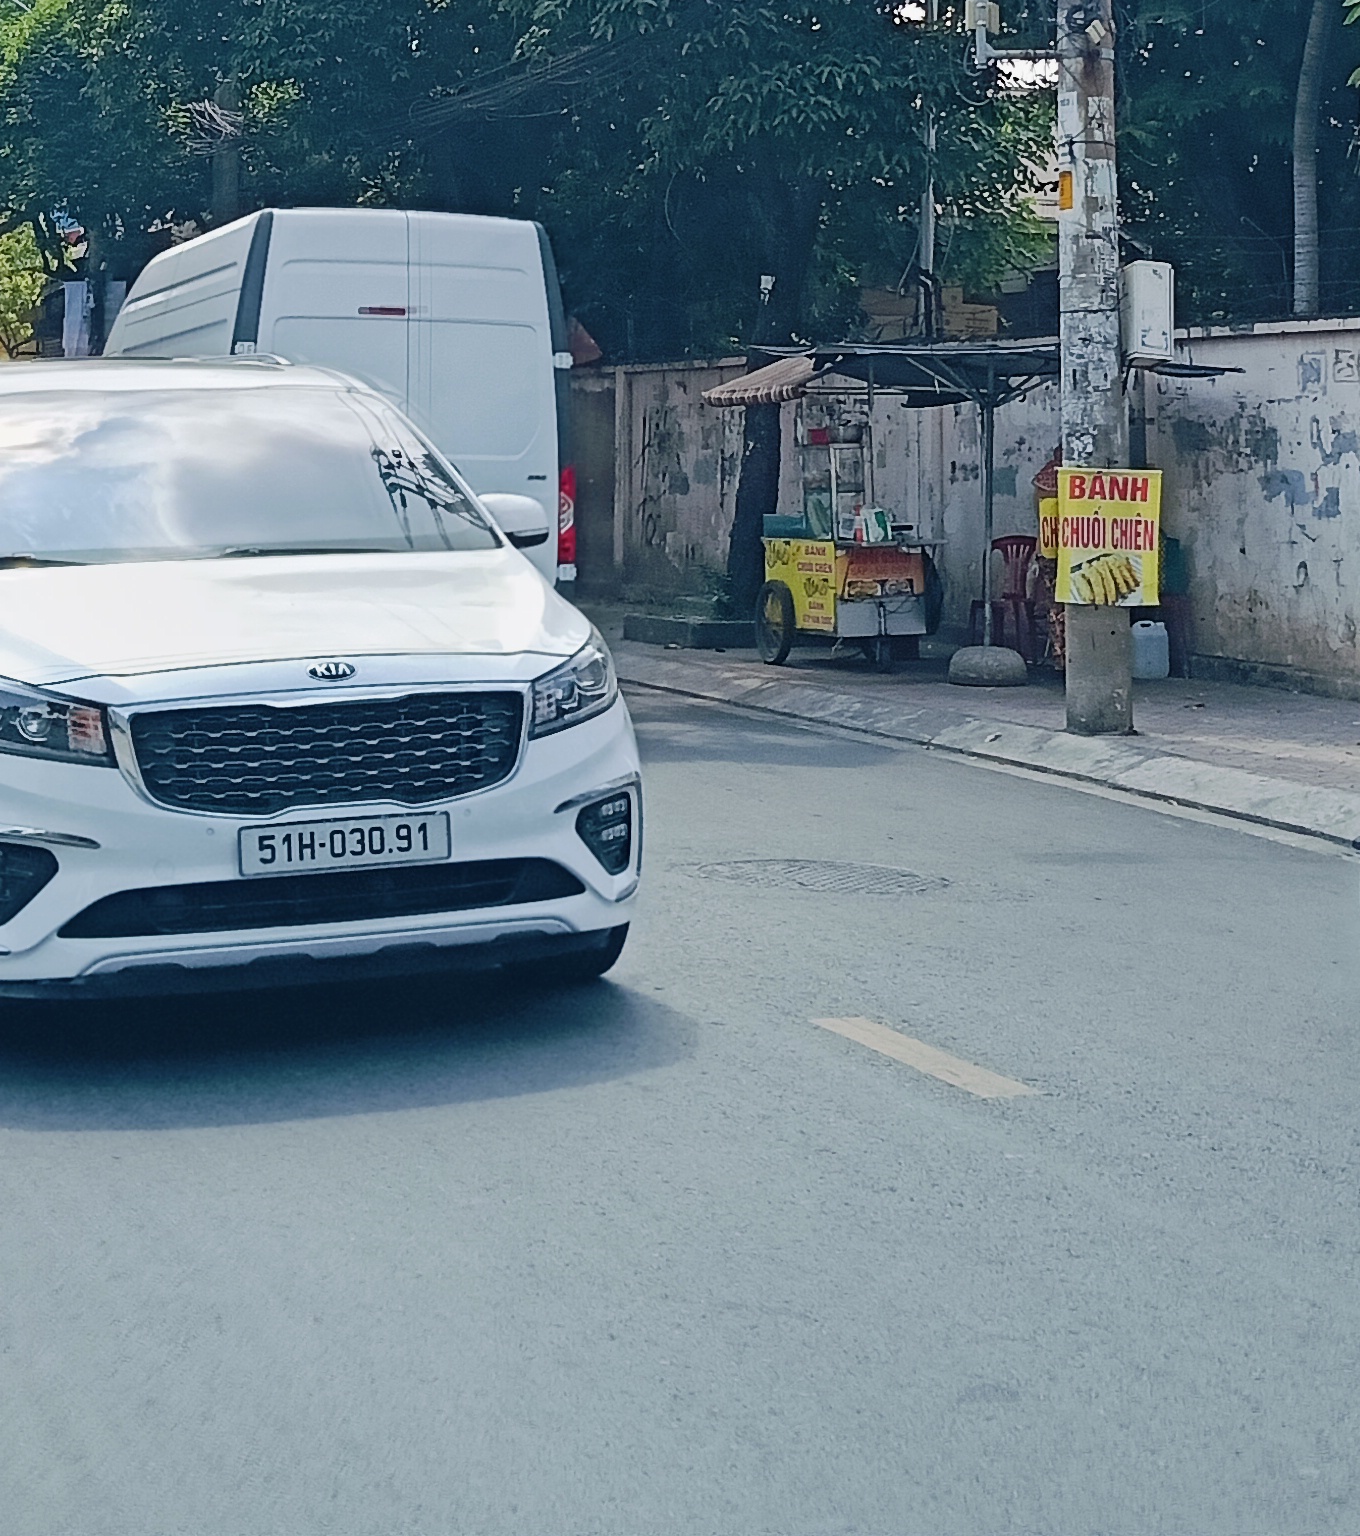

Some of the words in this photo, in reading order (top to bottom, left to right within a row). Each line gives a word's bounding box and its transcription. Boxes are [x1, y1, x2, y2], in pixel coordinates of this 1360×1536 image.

[1068, 471, 1149, 503] BÁNH
[1061, 506, 1106, 549] CHUỐI
[1111, 512, 1155, 551] CHIÊN
[311, 663, 353, 679] KIA
[257, 821, 430, 865] 51H-030.91
